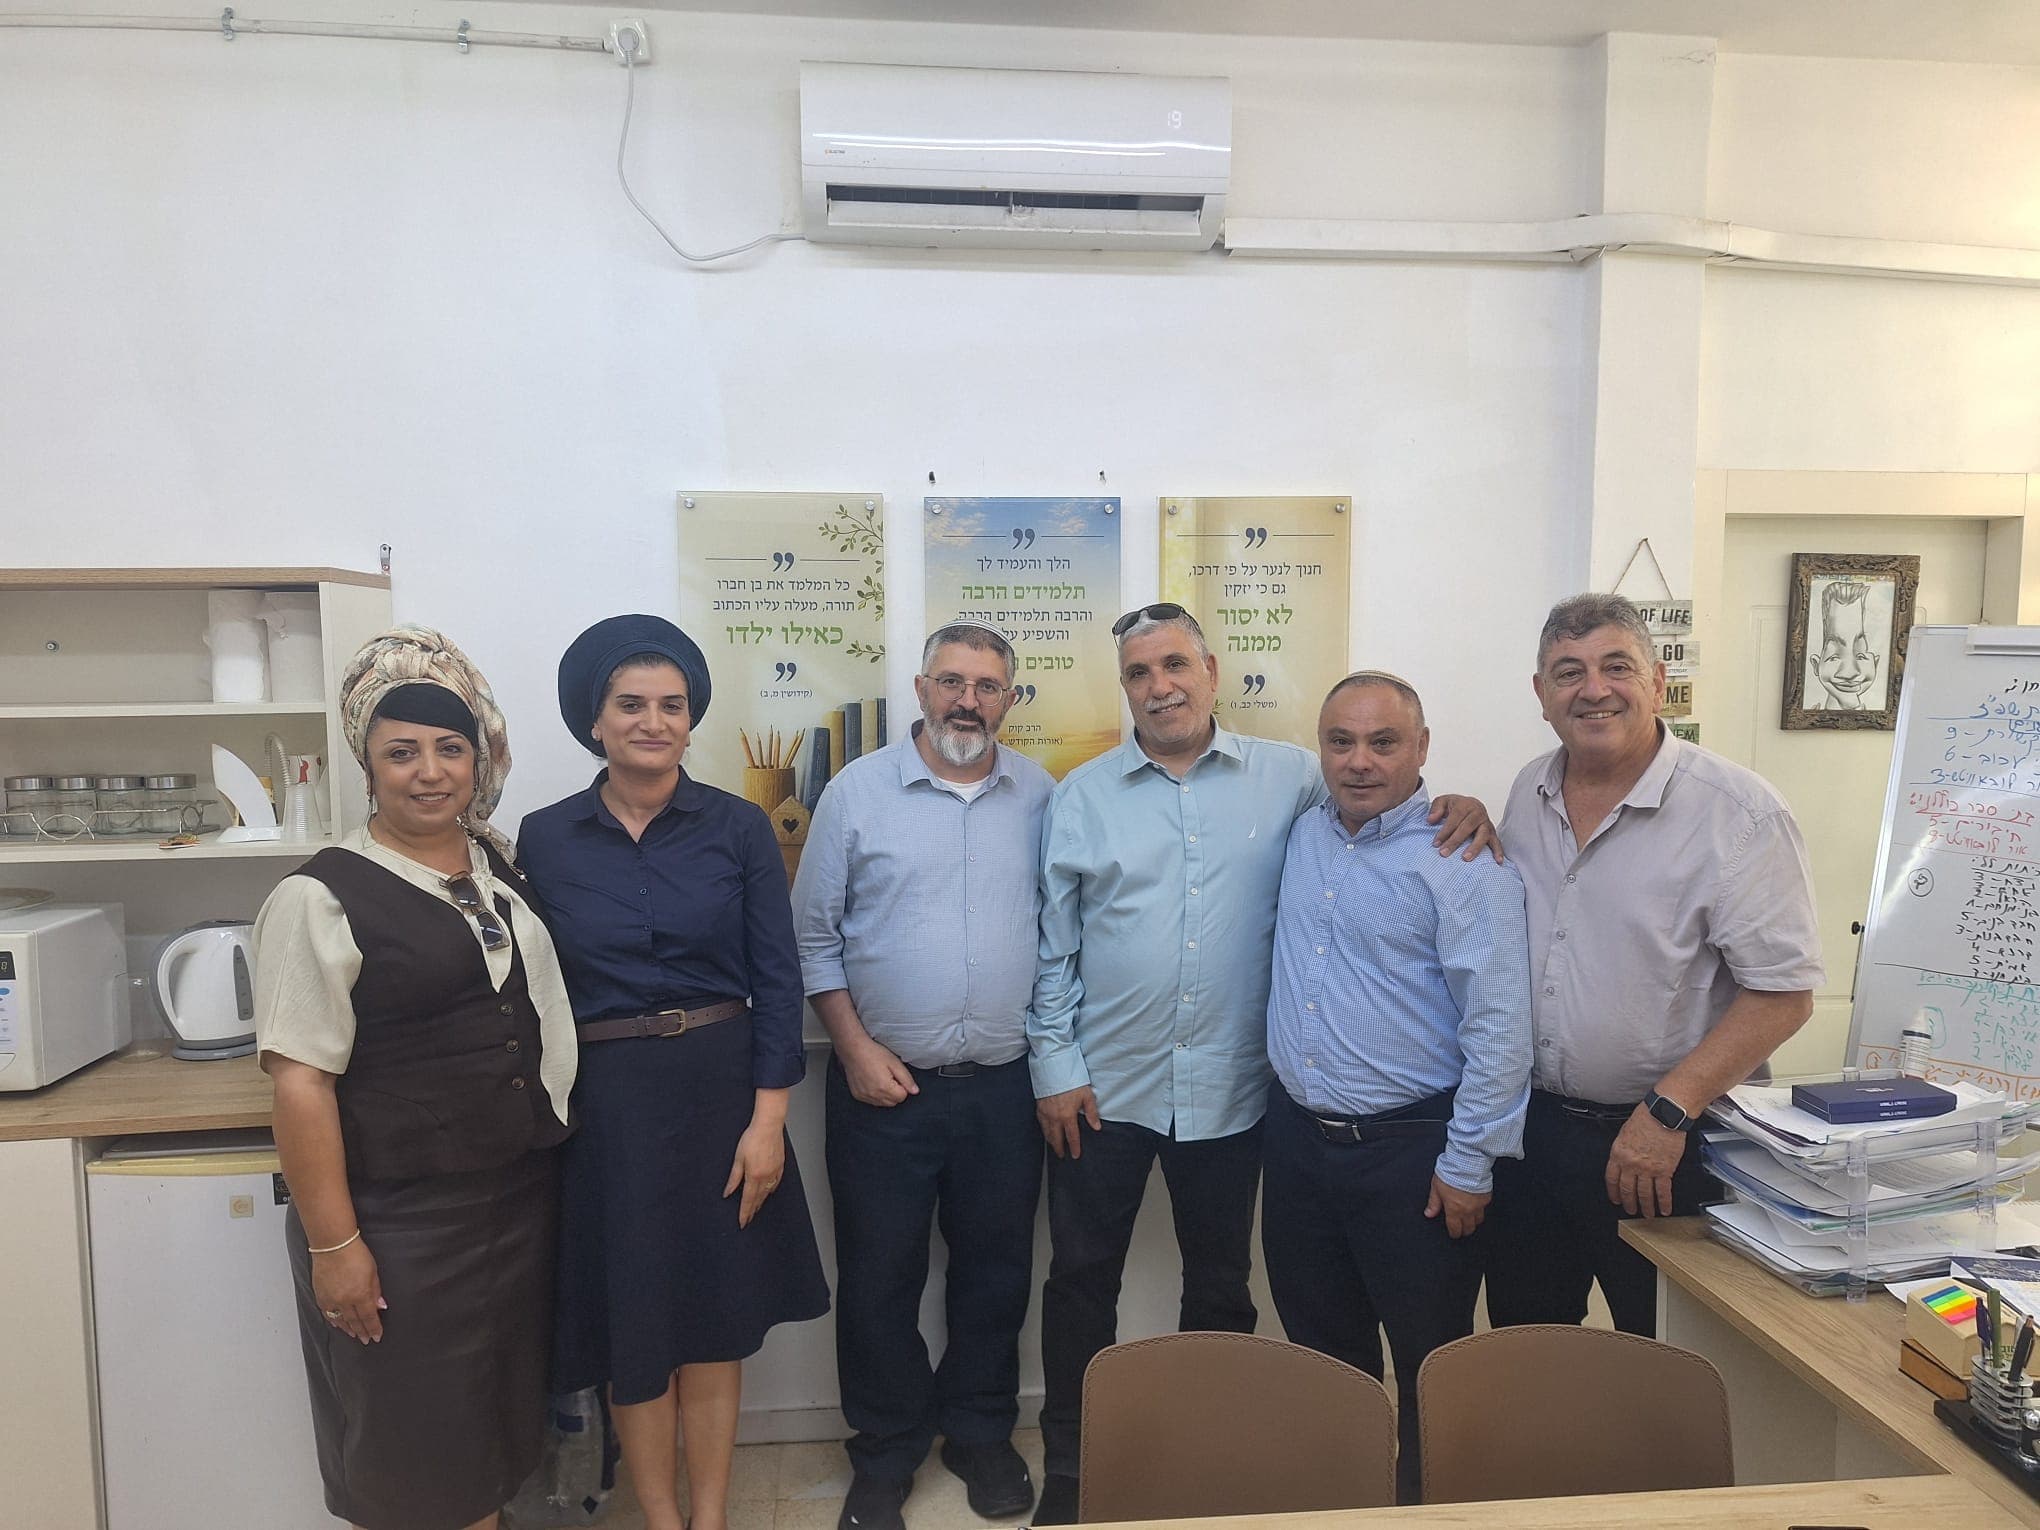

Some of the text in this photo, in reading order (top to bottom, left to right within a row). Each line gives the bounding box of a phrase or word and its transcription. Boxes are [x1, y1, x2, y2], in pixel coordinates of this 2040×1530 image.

[977, 556, 1071, 572] הלך והעמיד לך
[1189, 562, 1322, 579] חנוך לנער על פי דרכו,
[717, 579, 850, 593] כל המלמד את בן חברו
[962, 583, 1086, 600] תלמידים הרבה
[1224, 583, 1286, 597] גם כי יזקין
[713, 599, 855, 612] תורה, מעלה עליו הכתוב
[997, 609, 1050, 622] תלמידים
[1055, 611, 1092, 622] והרבה
[1217, 604, 1293, 625] לא יסור
[1661, 609, 1690, 624] LIFE
[726, 621, 844, 644] כאילו ילדו
[1022, 630, 1069, 641] והשפיע
[1228, 633, 1282, 652] ממנה
[1663, 644, 1683, 661] GO
[1026, 655, 1074, 670] טובים
[1666, 686, 1689, 704] ME
[1008, 724, 1041, 734] הרב קוק
